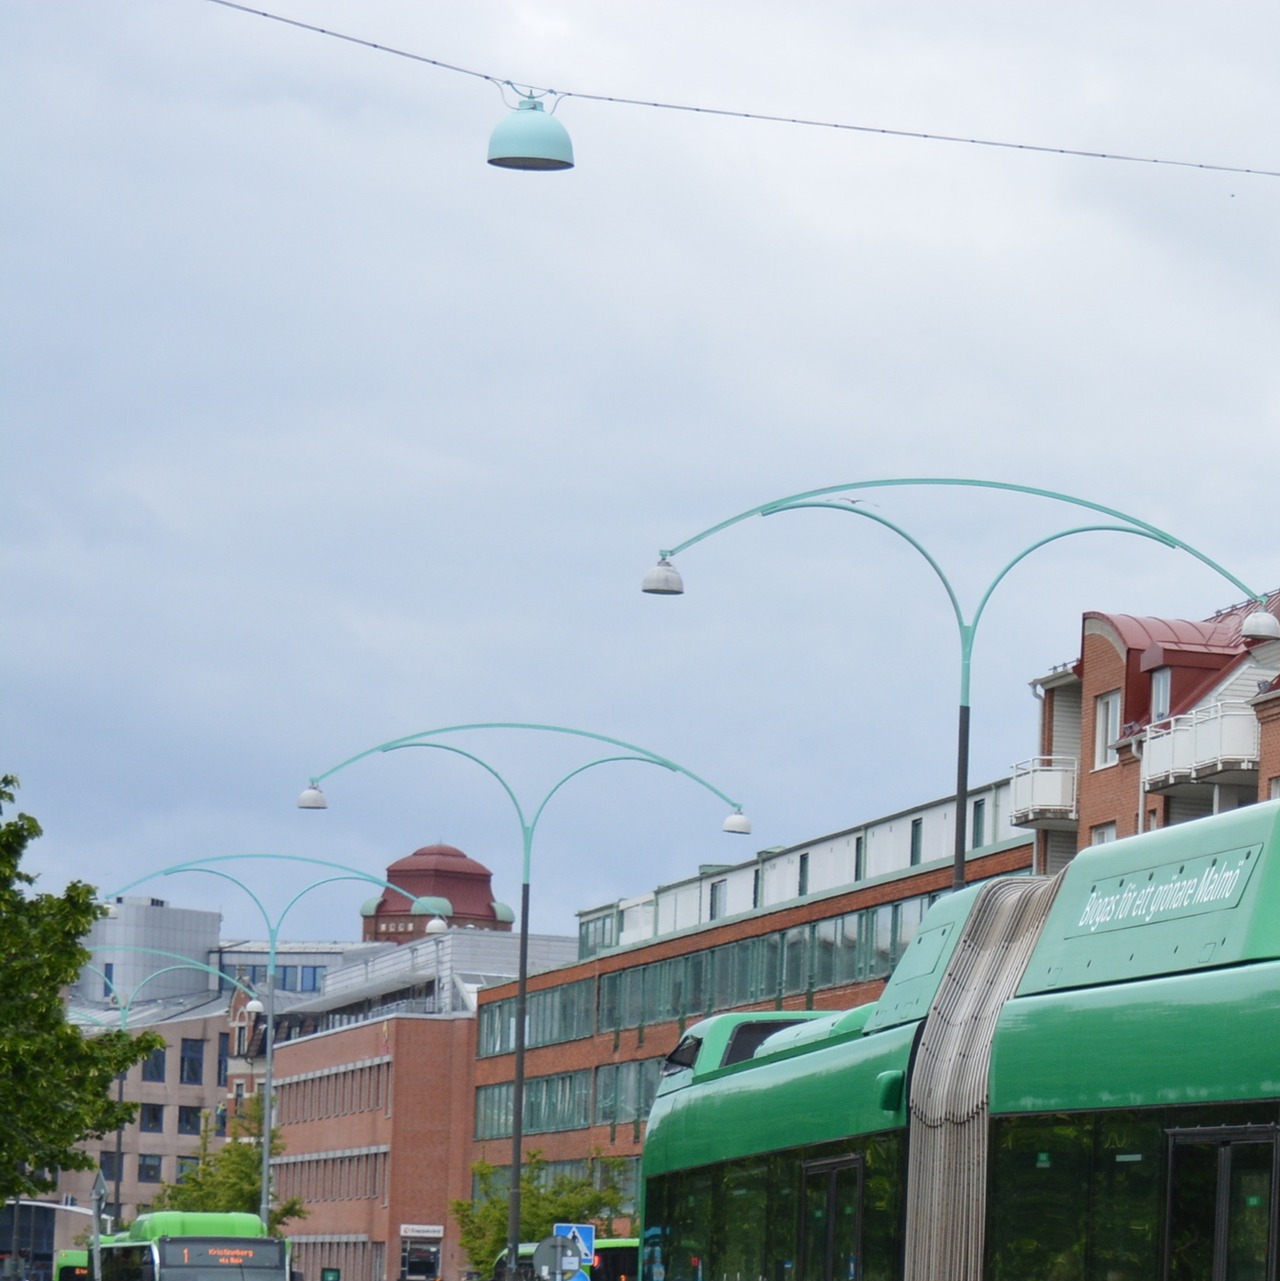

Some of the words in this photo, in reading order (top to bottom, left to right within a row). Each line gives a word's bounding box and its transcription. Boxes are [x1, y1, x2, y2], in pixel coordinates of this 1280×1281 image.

[1078, 891, 1117, 932] Biogas
[1114, 882, 1137, 920] för
[1132, 882, 1155, 918] ett
[1145, 875, 1198, 922] grönare
[1192, 860, 1244, 905] Malmö
[183, 1248, 189, 1264] 1
